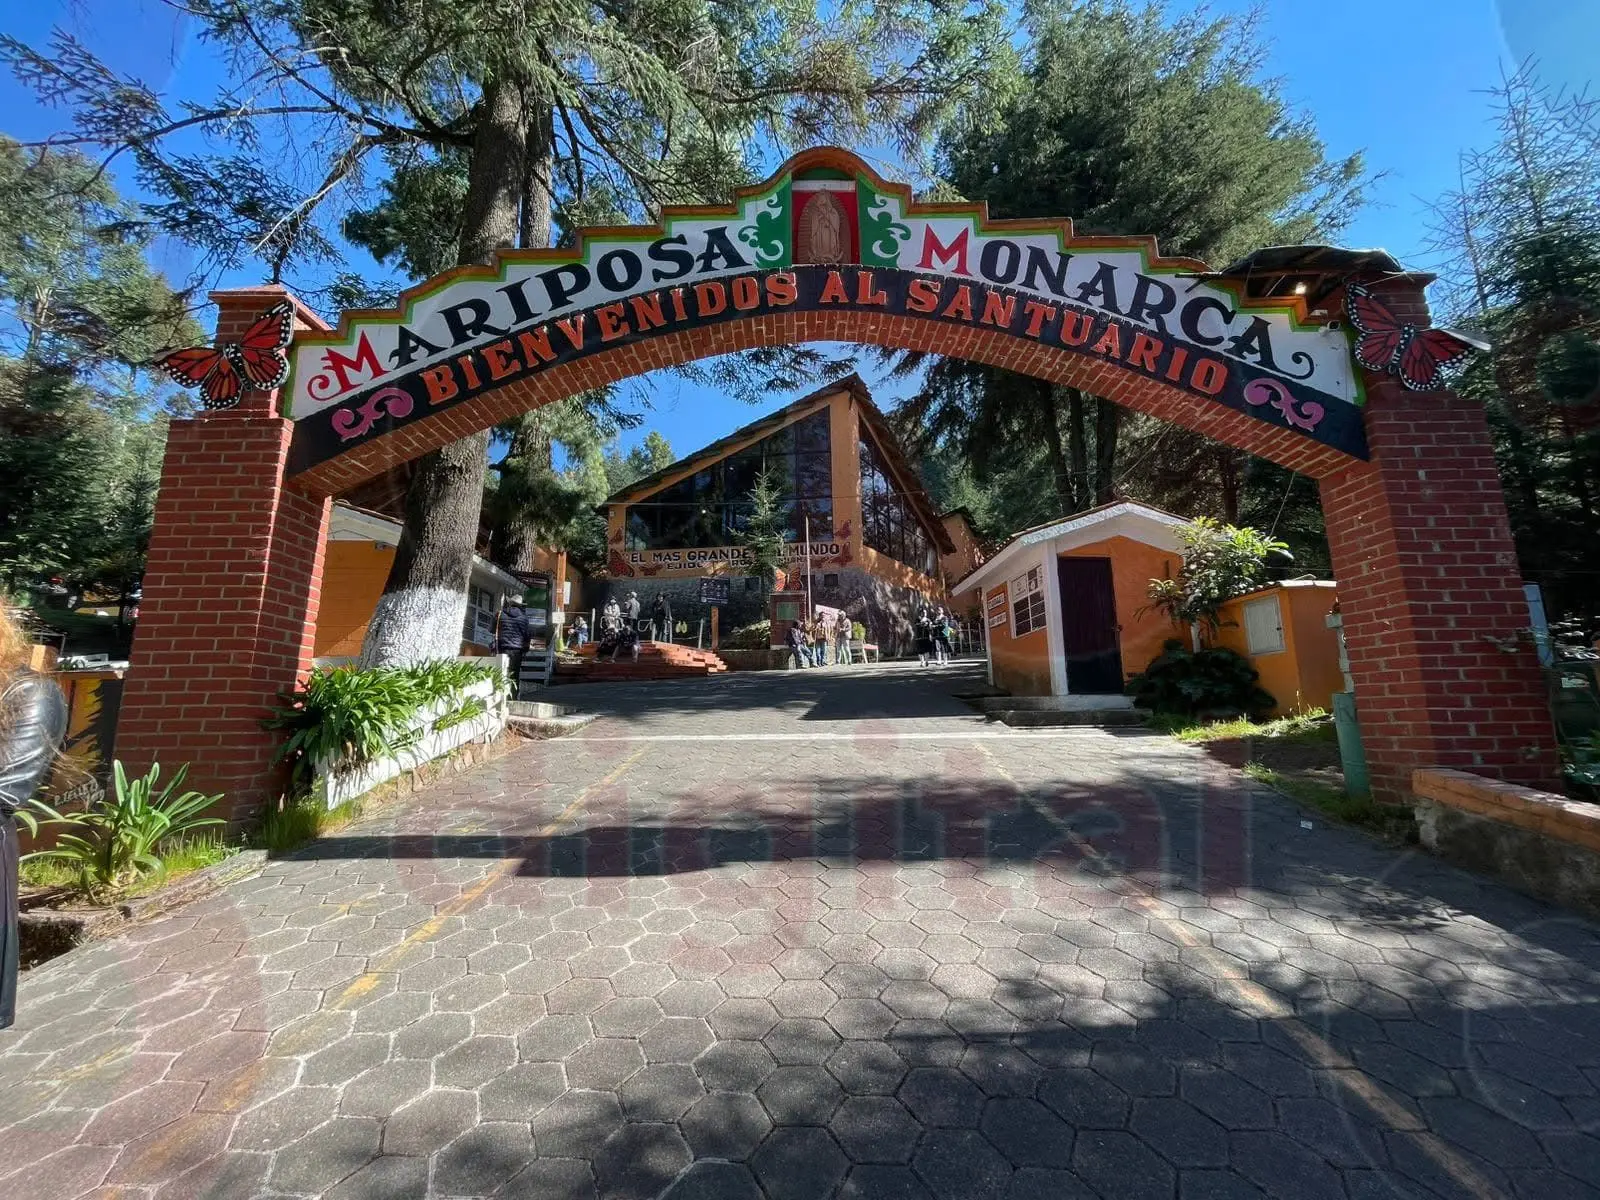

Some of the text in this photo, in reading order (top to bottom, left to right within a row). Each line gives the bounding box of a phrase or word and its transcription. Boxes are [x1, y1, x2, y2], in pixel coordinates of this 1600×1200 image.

[306, 225, 752, 401] MARIPOSA
[419, 270, 1229, 405] BIENVENIDOS AL SANTUARIO
[914, 222, 1316, 380] MONARCA
[631, 553, 646, 563] EL
[653, 551, 681, 562] MAS
[687, 547, 751, 561] GRANDE
[789, 543, 840, 557] MUNDO
